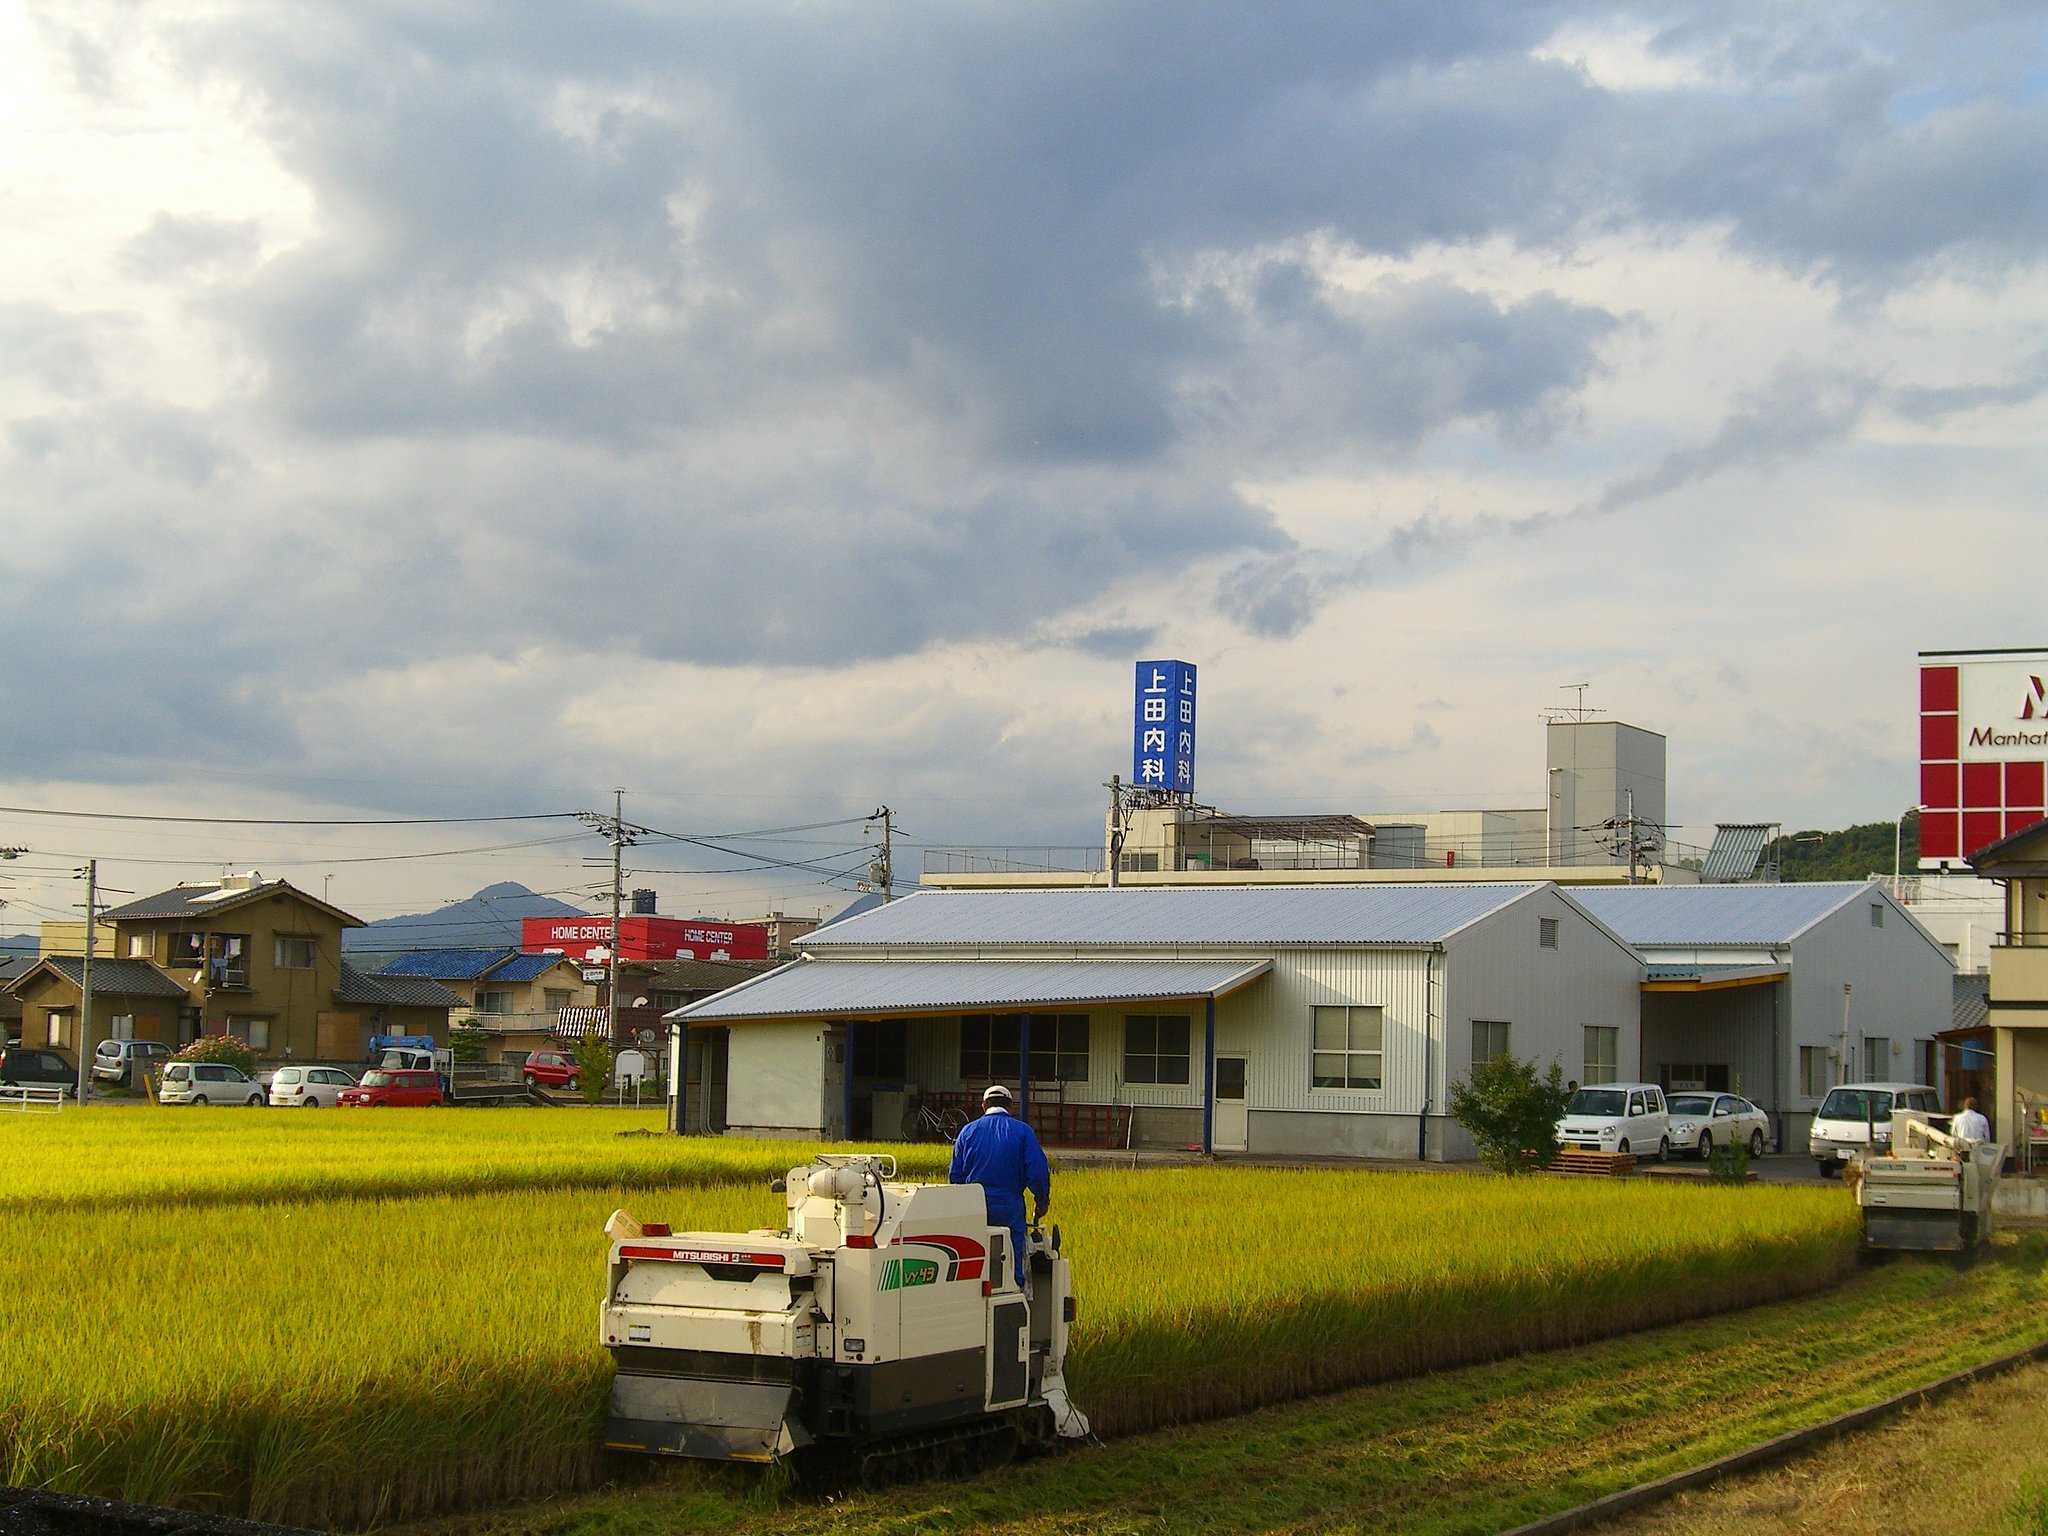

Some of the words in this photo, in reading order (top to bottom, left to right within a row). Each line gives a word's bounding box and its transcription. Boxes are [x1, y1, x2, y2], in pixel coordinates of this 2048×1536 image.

[1141, 668, 1167, 783] 上田内科
[1178, 670, 1193, 784] 上田内科
[551, 926, 579, 940] HOME
[684, 929, 705, 943] HOME
[705, 930, 733, 945] CENTER
[673, 1250, 729, 1262] MITSUBISHI
